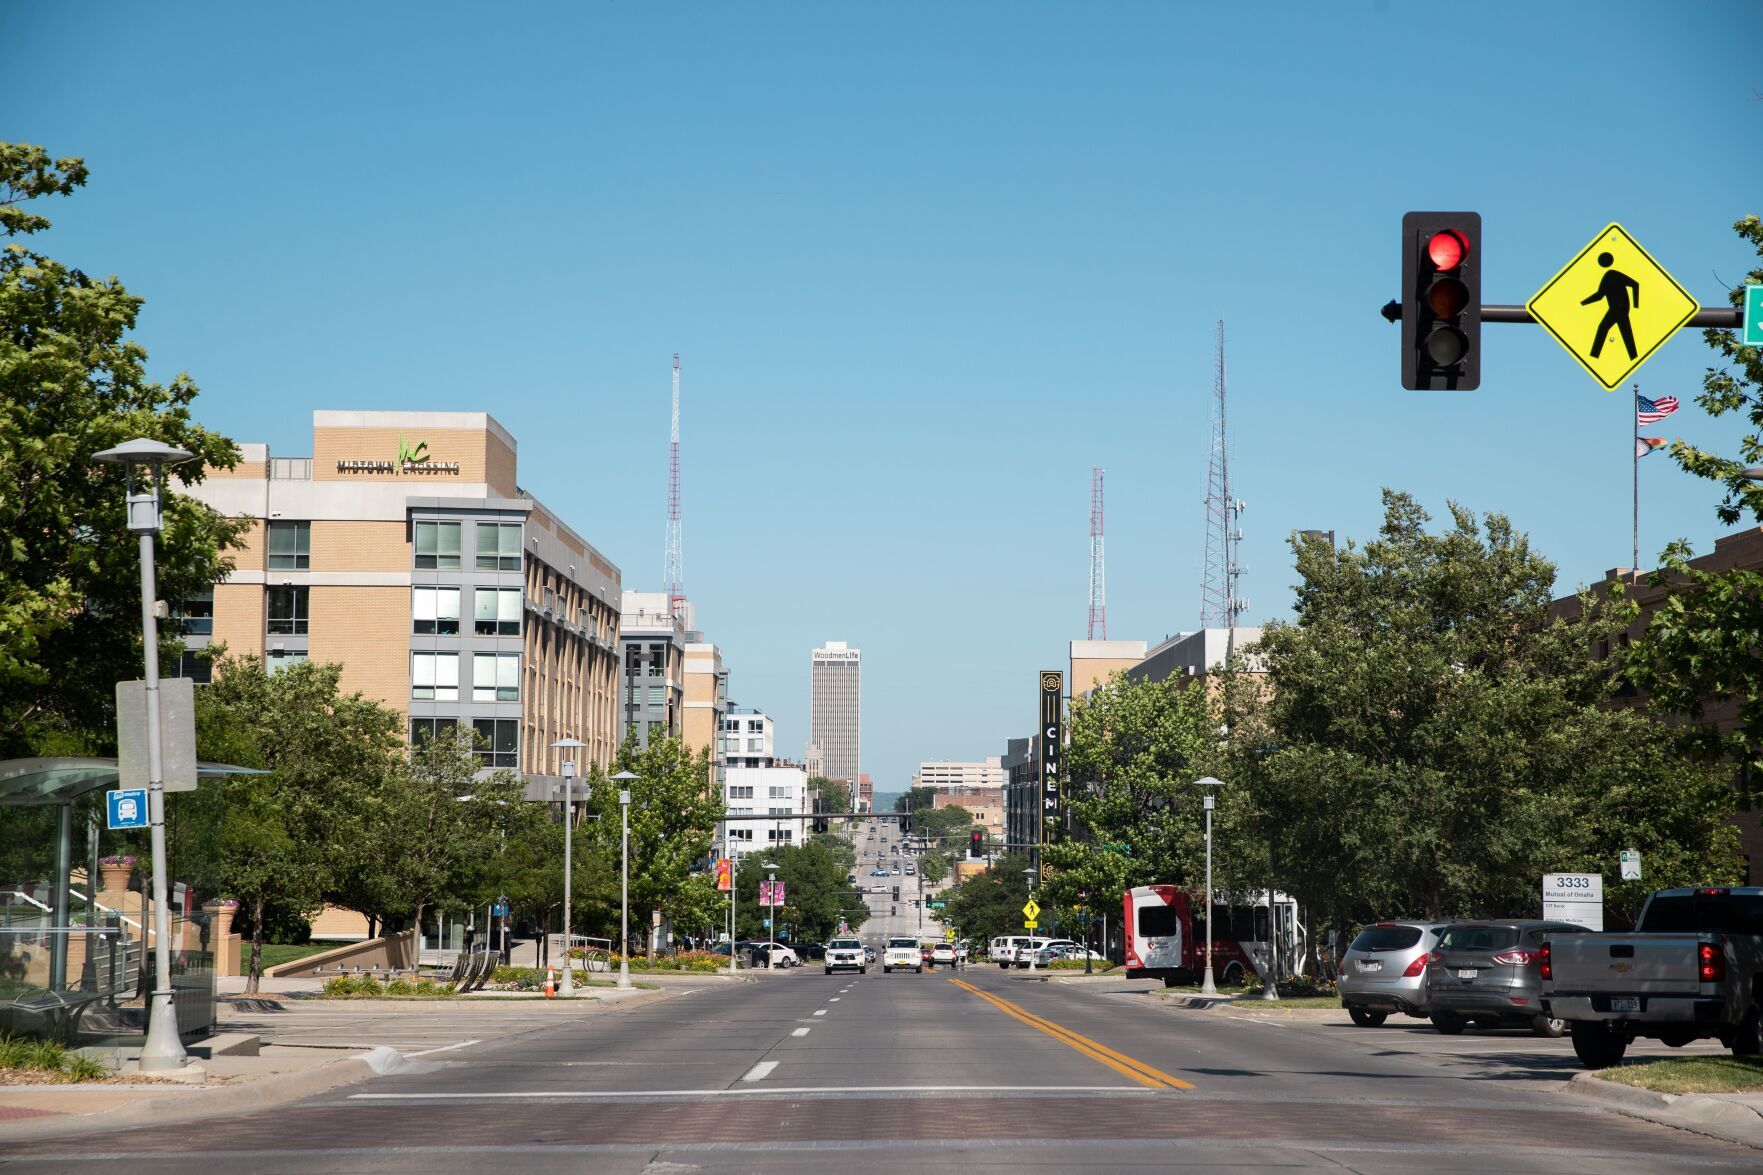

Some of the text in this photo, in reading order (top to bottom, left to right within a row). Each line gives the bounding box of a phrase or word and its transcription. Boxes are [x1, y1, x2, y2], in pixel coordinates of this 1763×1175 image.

[337, 460, 460, 476] MIDTOWN CROSSING
[813, 651, 859, 659] WoodmenLife
[1556, 877, 1589, 888] 3333
